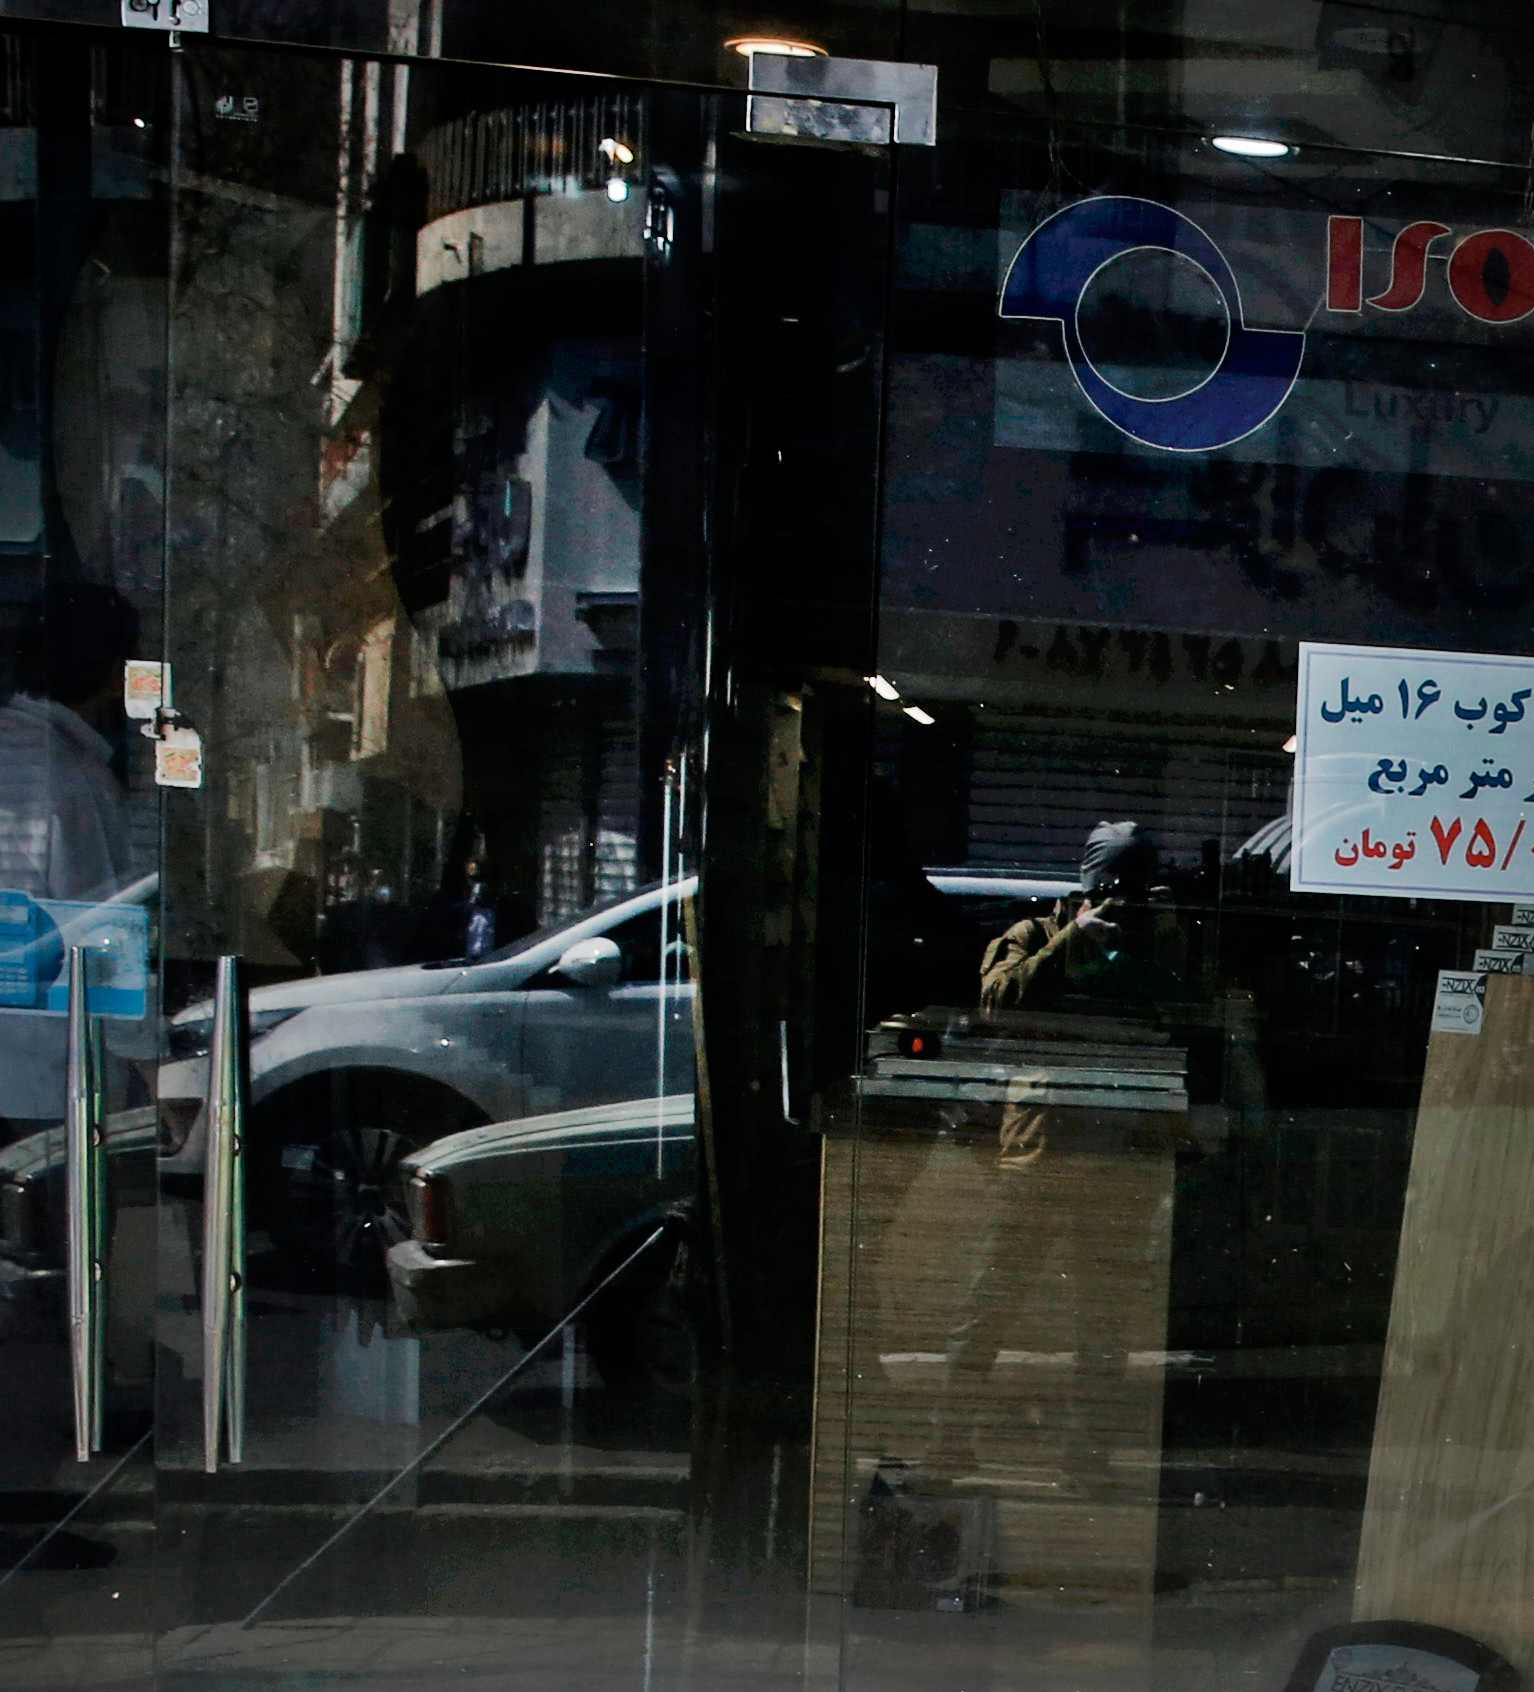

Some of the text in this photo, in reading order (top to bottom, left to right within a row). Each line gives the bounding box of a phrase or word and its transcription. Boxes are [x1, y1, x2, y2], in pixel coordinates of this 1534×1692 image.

[1320, 677, 1383, 724] میل
[1397, 678, 1442, 721] ۱۶
[1454, 688, 1533, 734] کوب
[1367, 758, 1449, 796] مربع
[1459, 758, 1513, 799] متر
[1334, 828, 1417, 869] تومان
